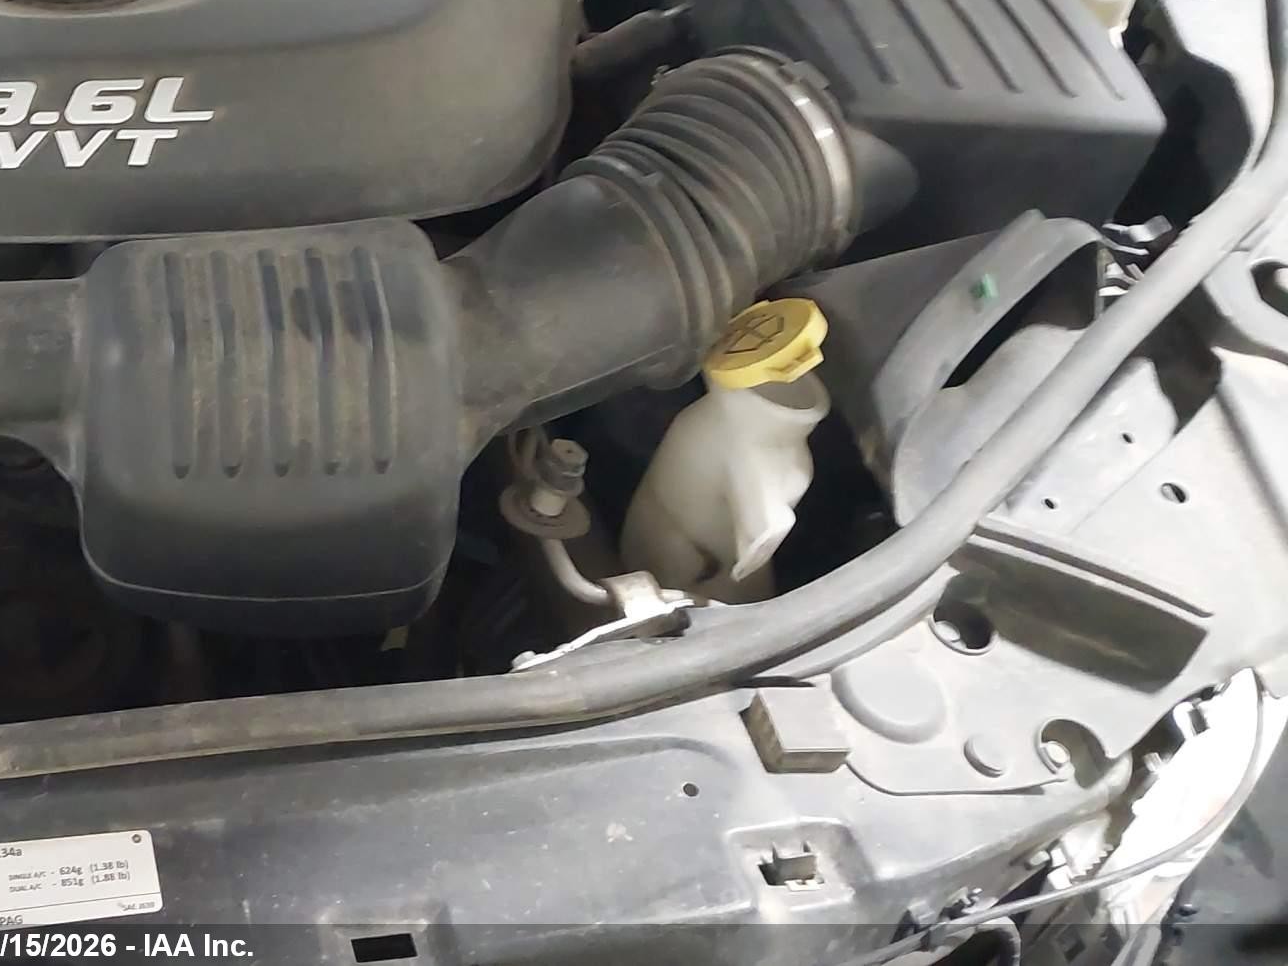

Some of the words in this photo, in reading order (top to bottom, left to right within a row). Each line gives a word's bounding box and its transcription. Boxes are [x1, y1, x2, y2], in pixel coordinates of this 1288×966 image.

[59, 866, 83, 876] 624g
[115, 859, 129, 870] lb)
[61, 877, 85, 888] 851g
[117, 870, 131, 881] lb)
[0, 914, 24, 926] PAG
